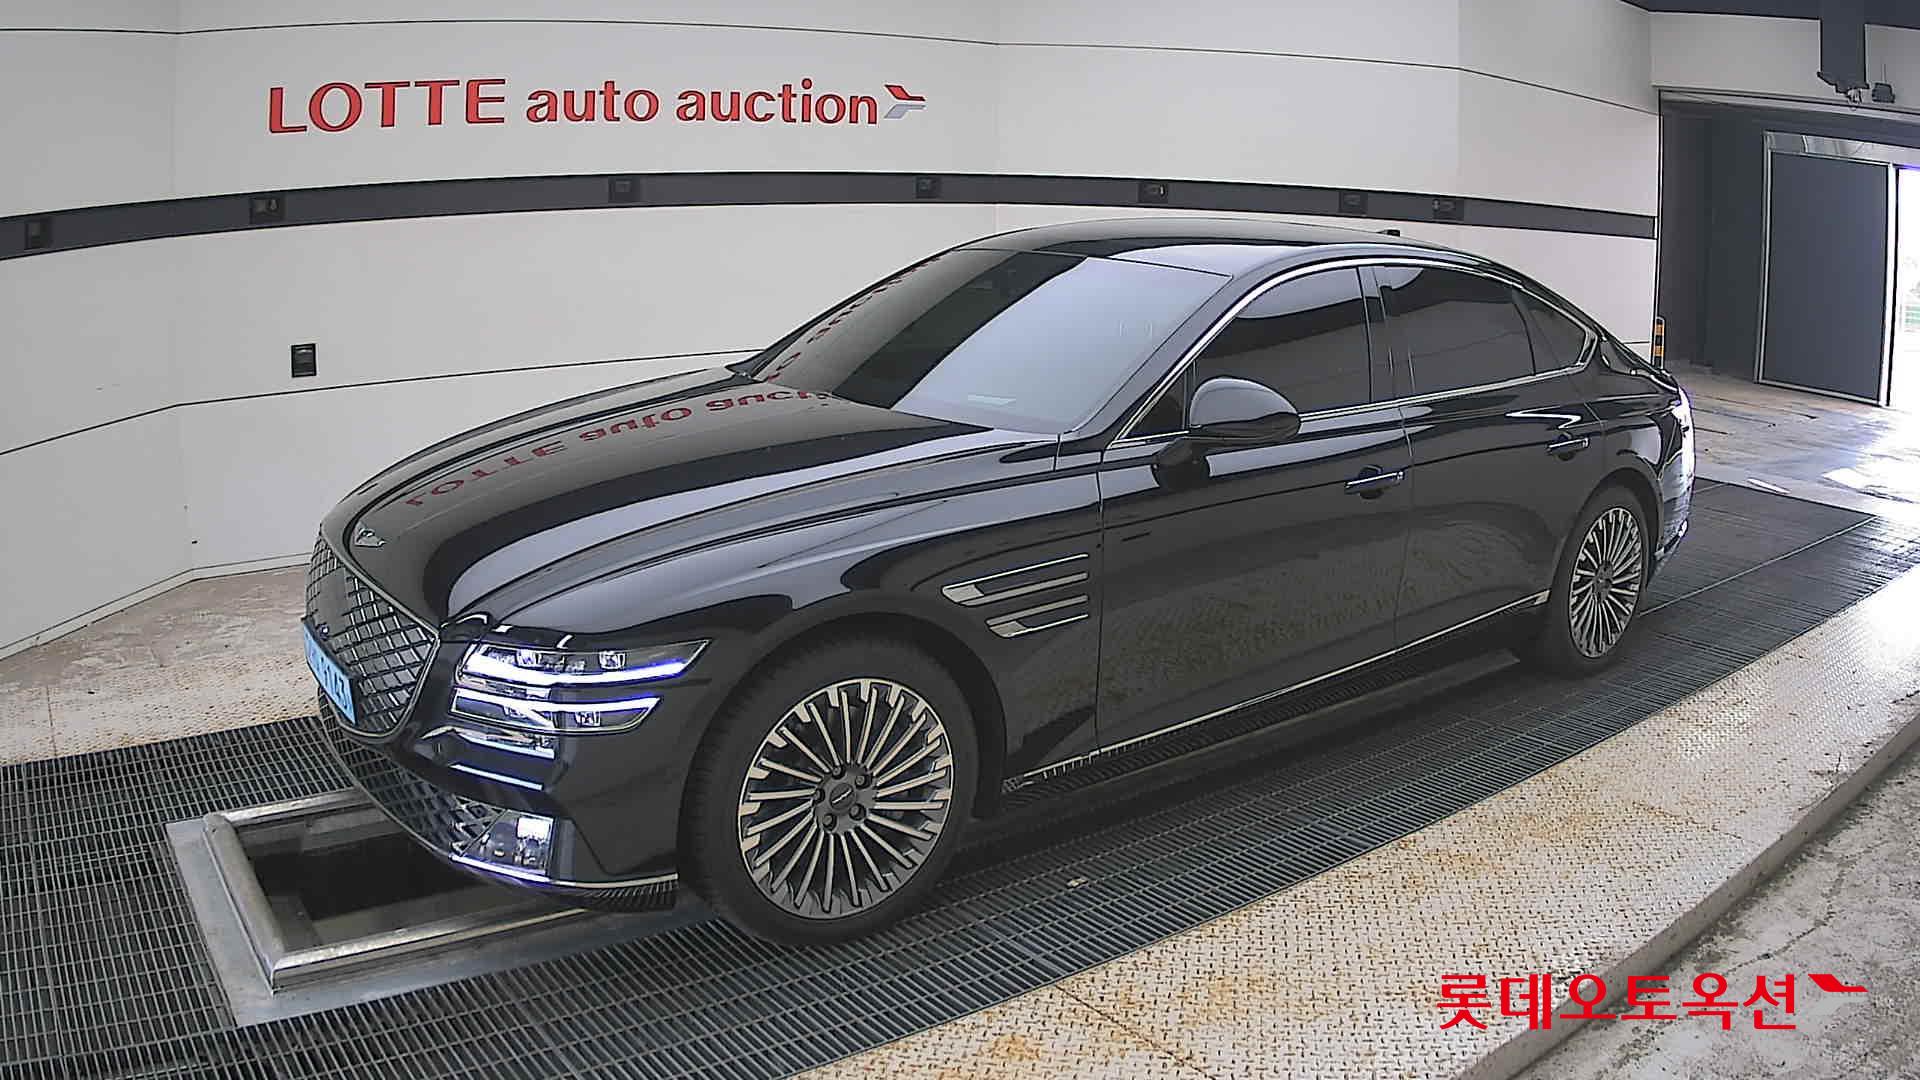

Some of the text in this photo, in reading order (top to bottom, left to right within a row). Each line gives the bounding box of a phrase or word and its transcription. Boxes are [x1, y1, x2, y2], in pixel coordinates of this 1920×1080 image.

[268, 78, 878, 134] LOTTE auto auction
